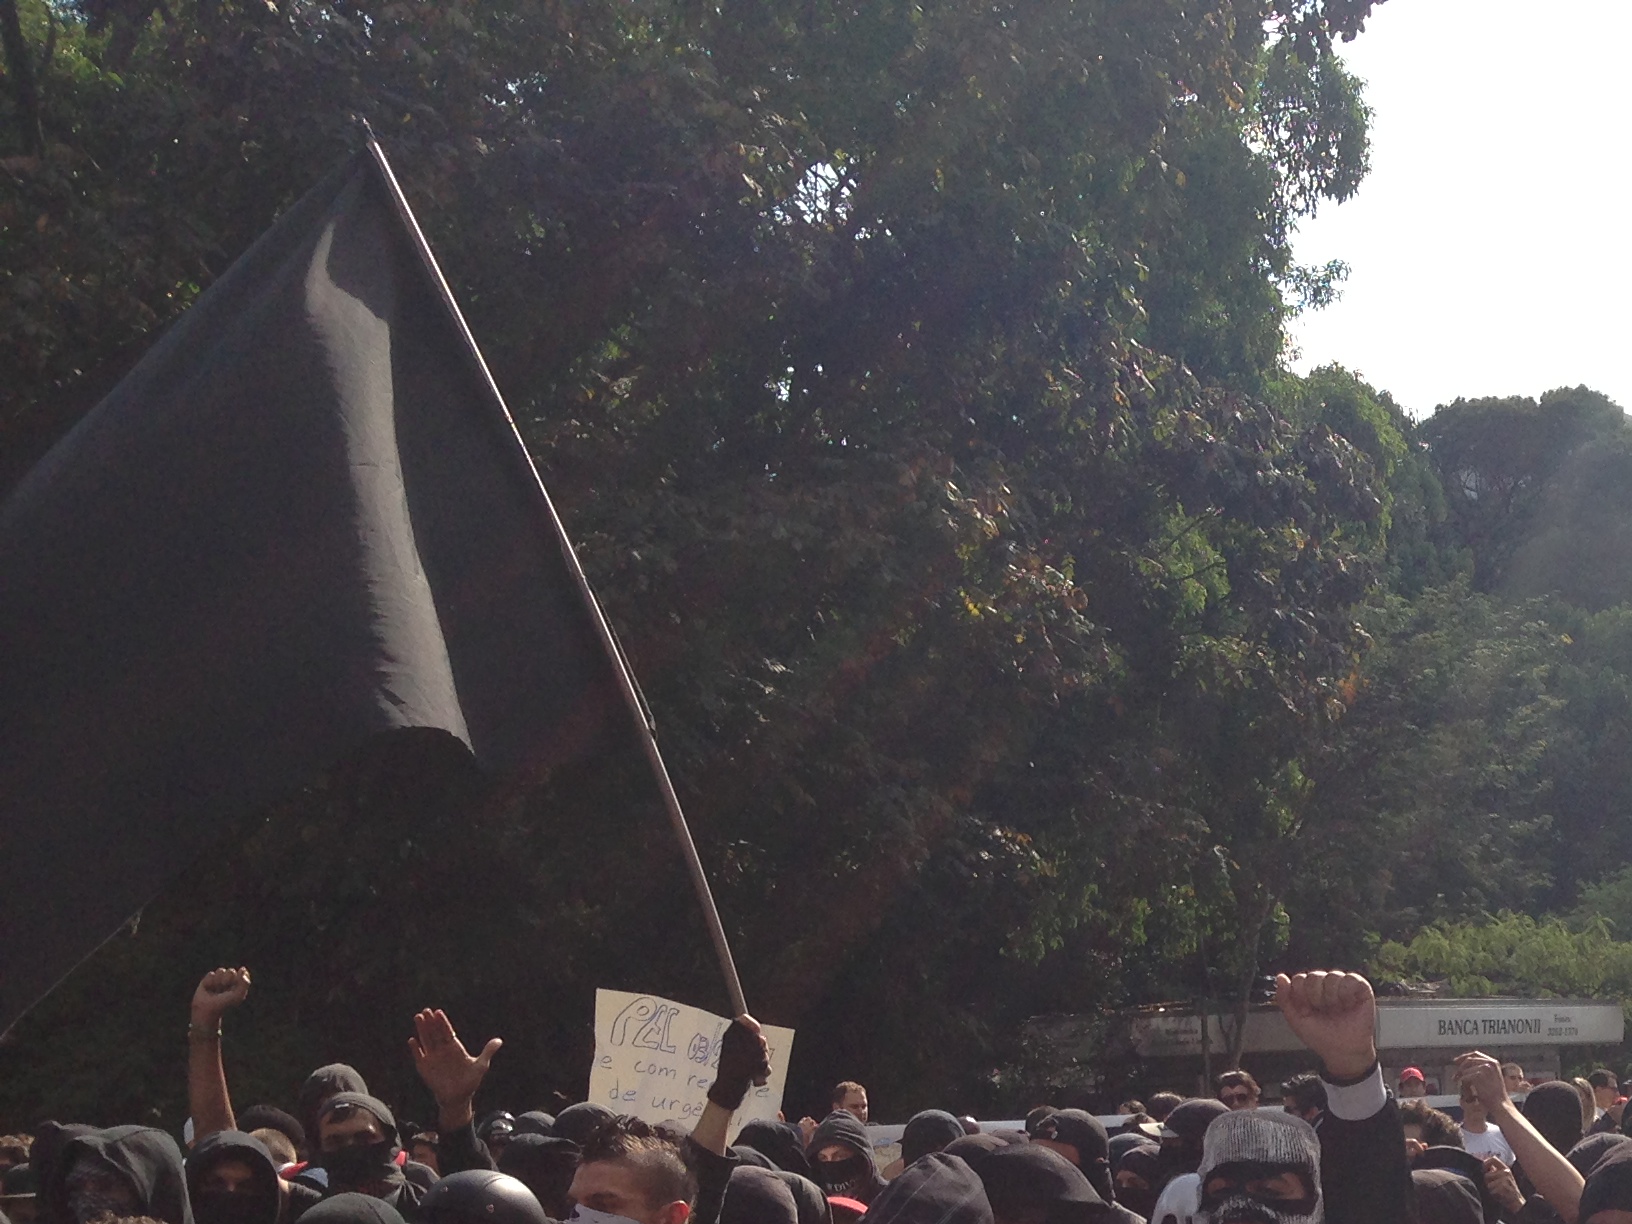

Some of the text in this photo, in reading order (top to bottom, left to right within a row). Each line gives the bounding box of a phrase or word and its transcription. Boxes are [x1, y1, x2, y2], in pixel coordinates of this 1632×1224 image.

[1438, 1019, 1479, 1036] BANCA
[634, 1060, 677, 1080] com
[609, 1077, 636, 1101] de
